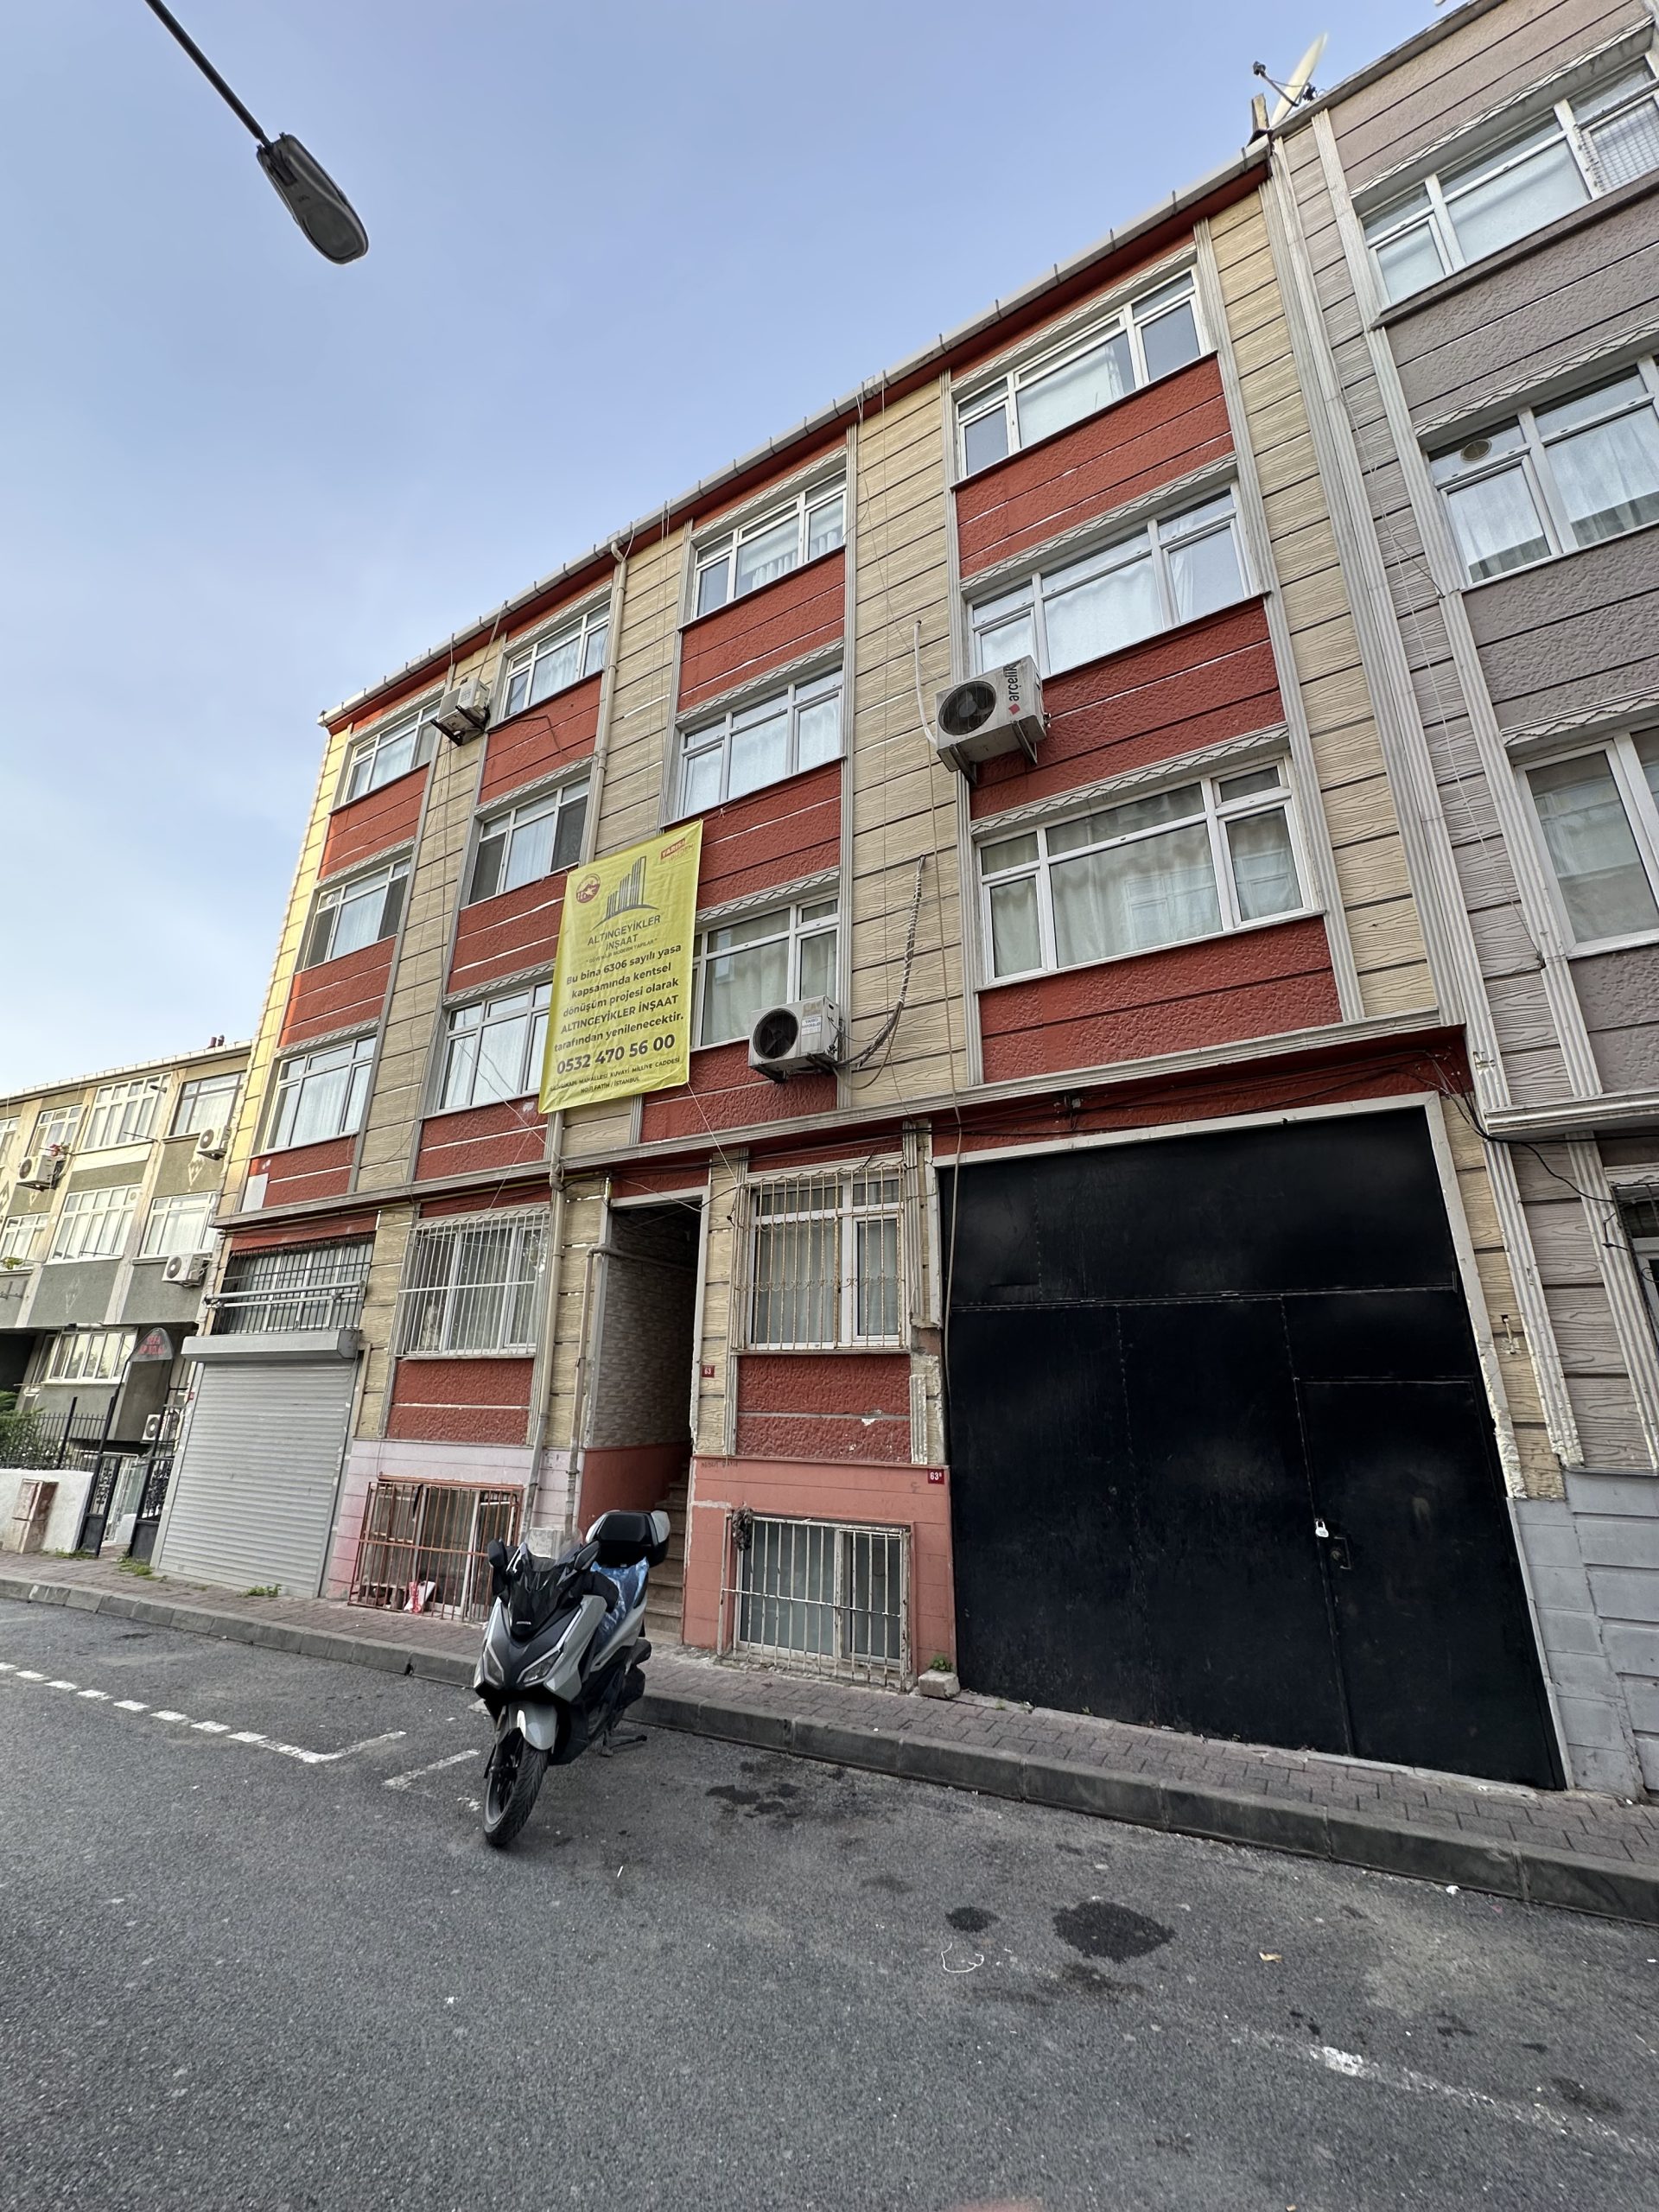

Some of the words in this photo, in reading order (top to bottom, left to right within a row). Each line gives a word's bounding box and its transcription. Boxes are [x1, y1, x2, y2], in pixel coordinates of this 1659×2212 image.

[1002, 659, 1021, 702] arçelik
[588, 914, 661, 946] ALTINGEYİKLER
[606, 933, 639, 951] İNŞAAT
[566, 975, 578, 985] Bu
[581, 969, 601, 982] bina
[603, 959, 627, 973] 6306
[629, 951, 655, 966] sayılı
[658, 944, 682, 959] yasa
[571, 976, 631, 999] kapsamında
[633, 963, 671, 982] kentsel
[561, 1006, 636, 1034] ALTINGEYİKLER
[639, 995, 679, 1014] İNŞAAT
[563, 999, 607, 1018] dönüşüm
[609, 986, 644, 1006] projesi
[645, 978, 679, 994] olarak
[554, 1031, 604, 1052] tarafından
[606, 1011, 684, 1041] yenilenecektir.
[556, 1053, 591, 1075] 0532
[594, 1046, 625, 1065] 470
[628, 1039, 649, 1058] 56
[652, 1033, 676, 1052] 00
